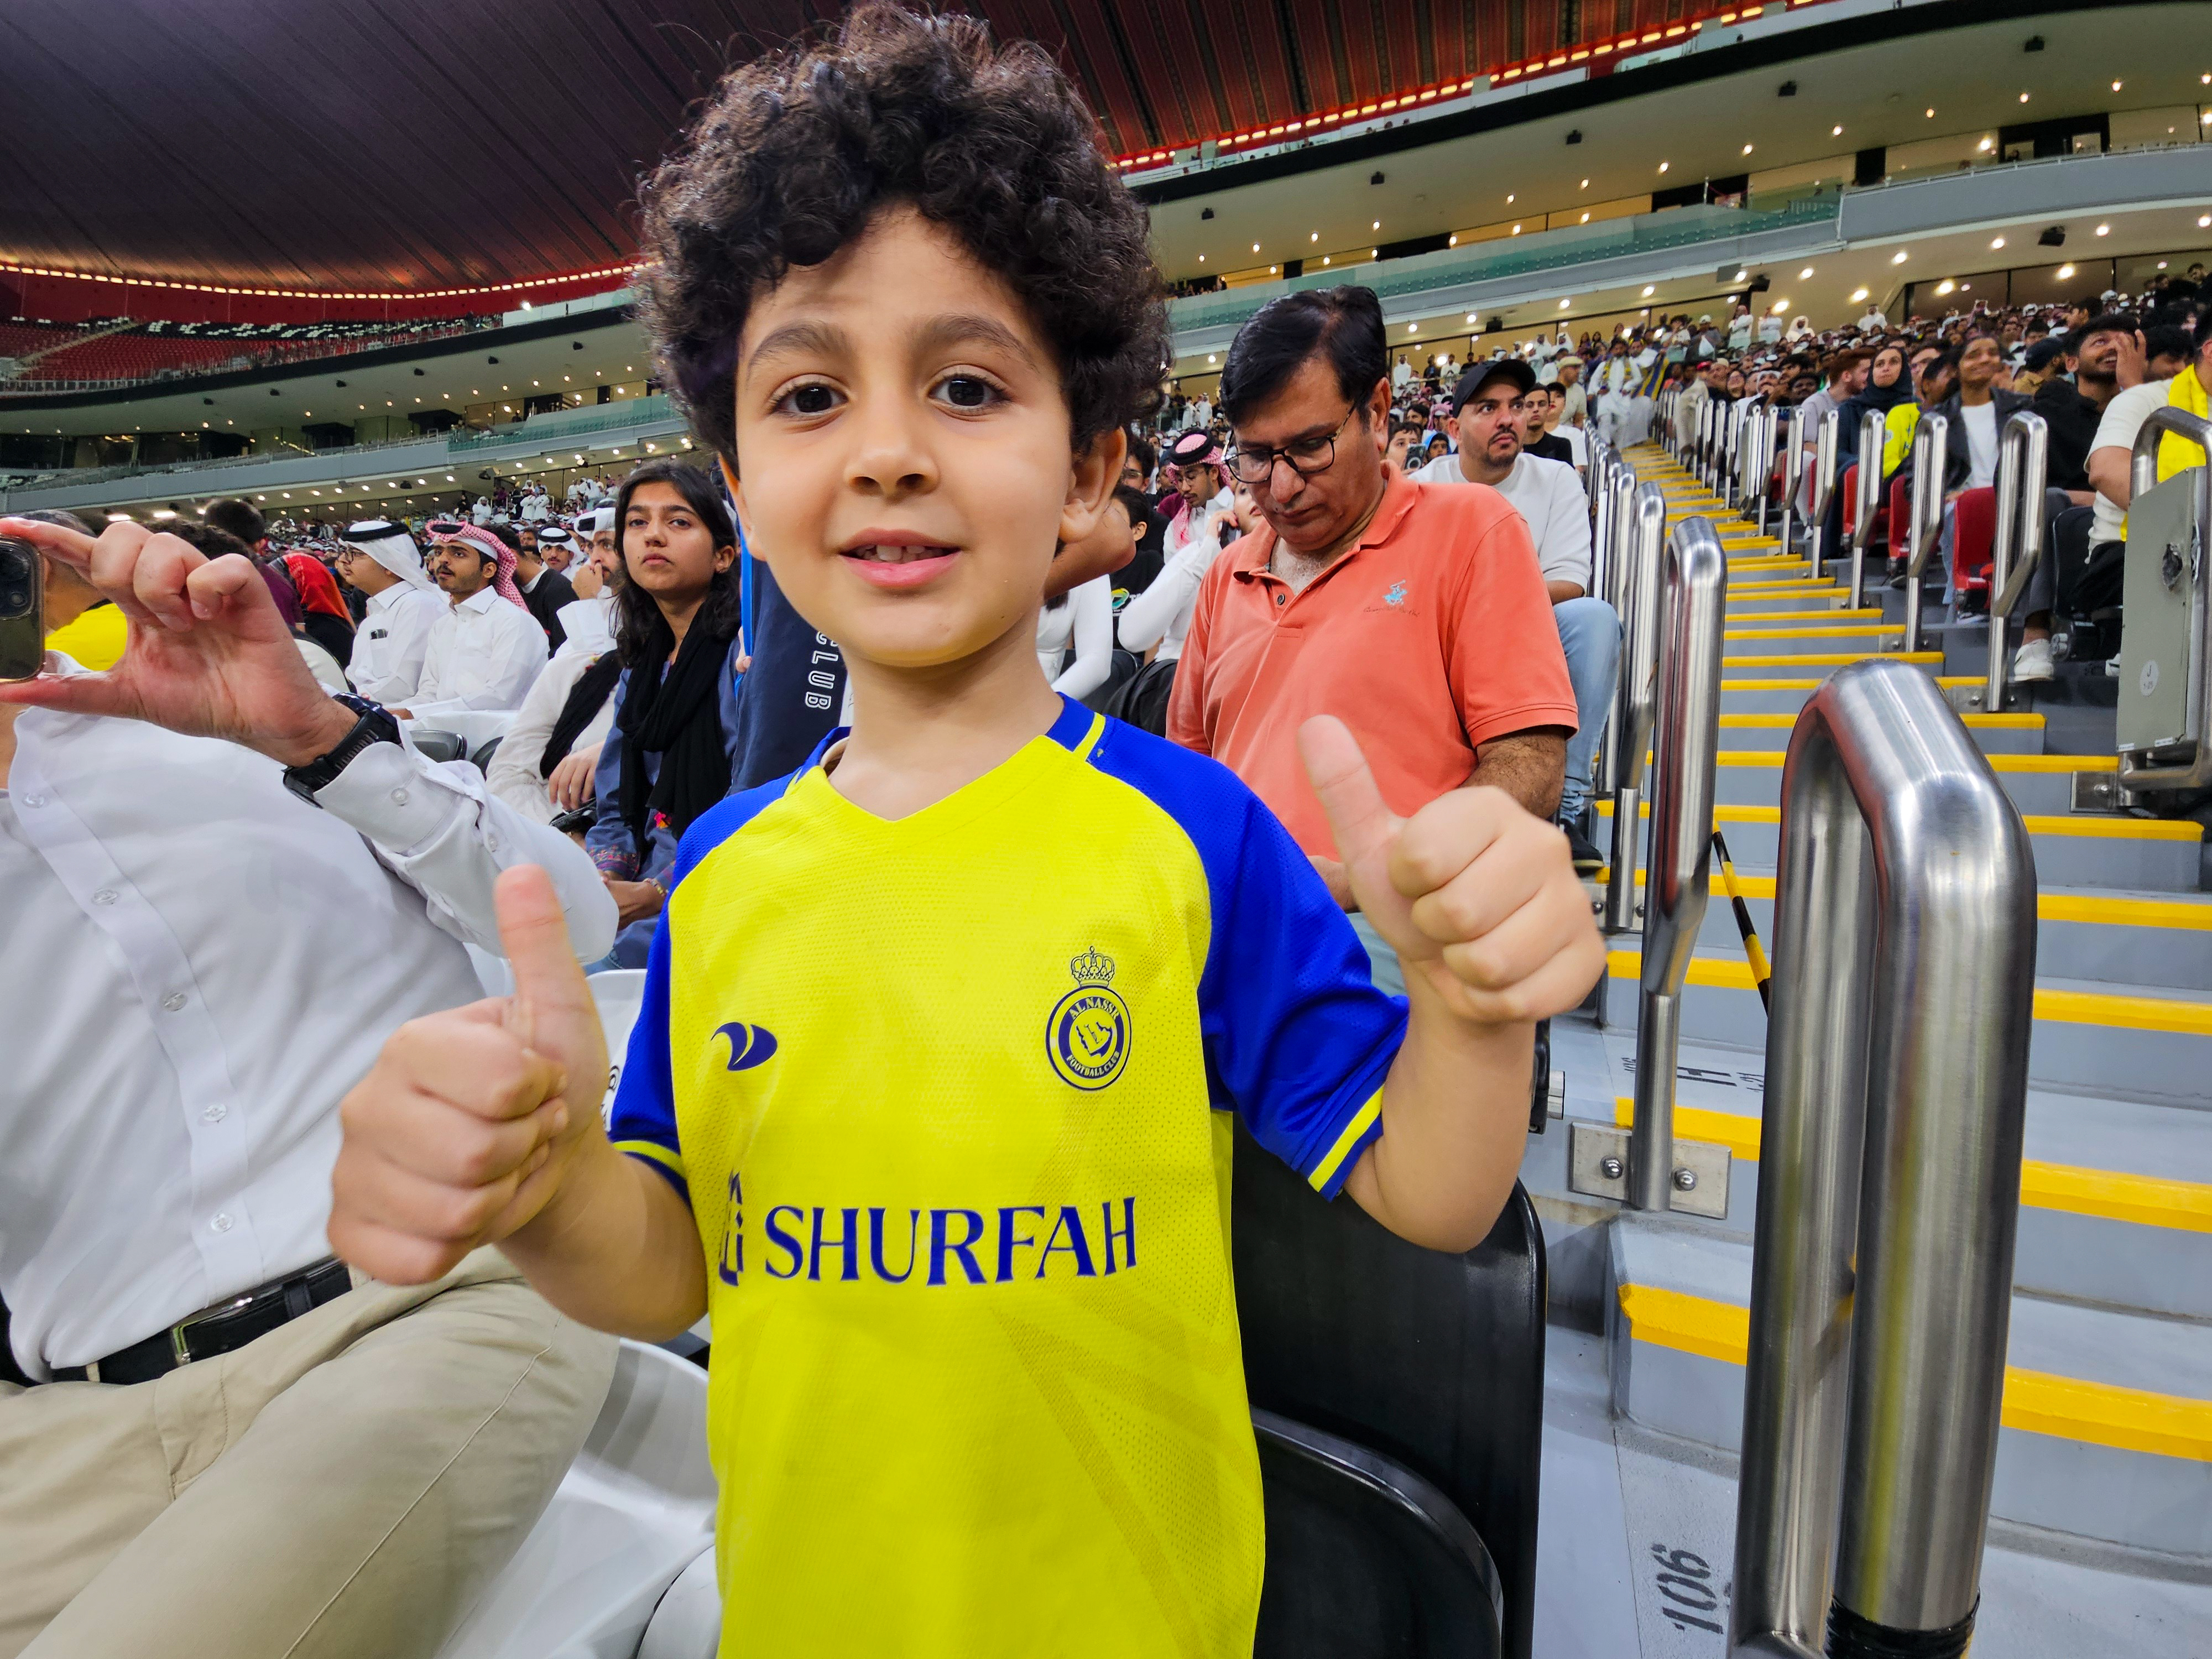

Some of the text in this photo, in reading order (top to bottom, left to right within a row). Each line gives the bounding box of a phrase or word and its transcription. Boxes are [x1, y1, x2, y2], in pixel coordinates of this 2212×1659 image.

[1085, 997, 1120, 1021] NASSR
[1066, 1053, 1104, 1077] FOOTBALL
[764, 1196, 1136, 1286] SHURFAH
[1650, 1543, 1724, 1635] 106
